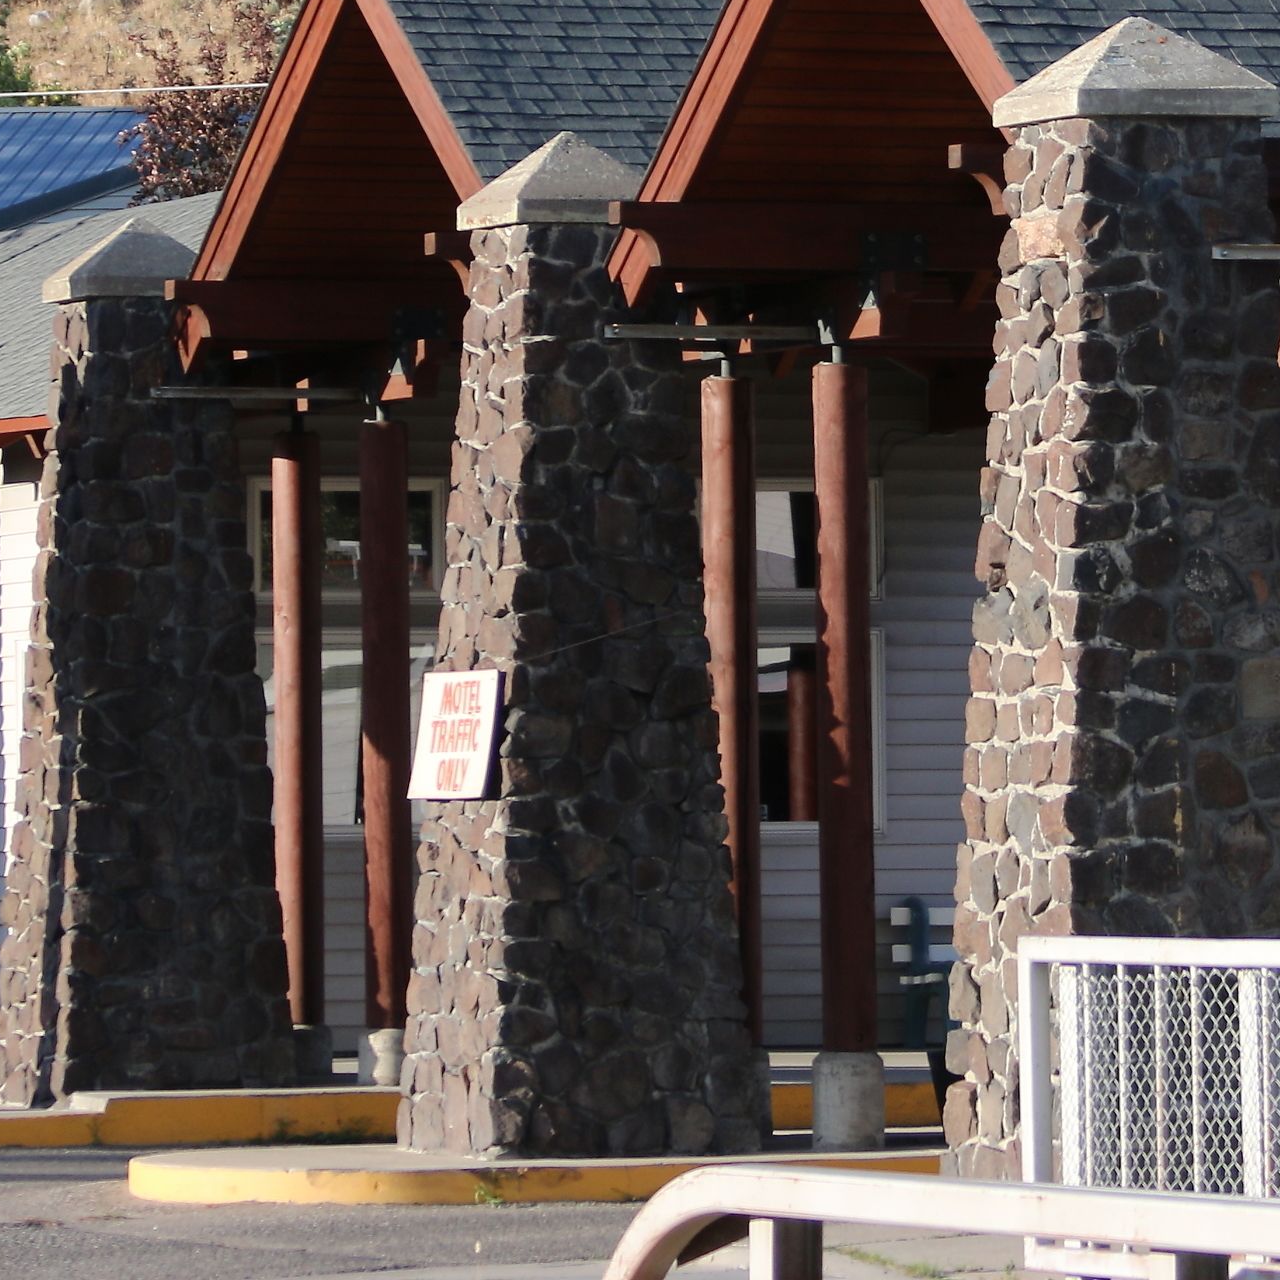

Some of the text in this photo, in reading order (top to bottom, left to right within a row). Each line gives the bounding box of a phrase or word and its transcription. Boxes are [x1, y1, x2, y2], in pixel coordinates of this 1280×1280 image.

[440, 679, 482, 715] MOTEL
[430, 719, 481, 754] TRAFFIC
[435, 757, 471, 792] ONLY
